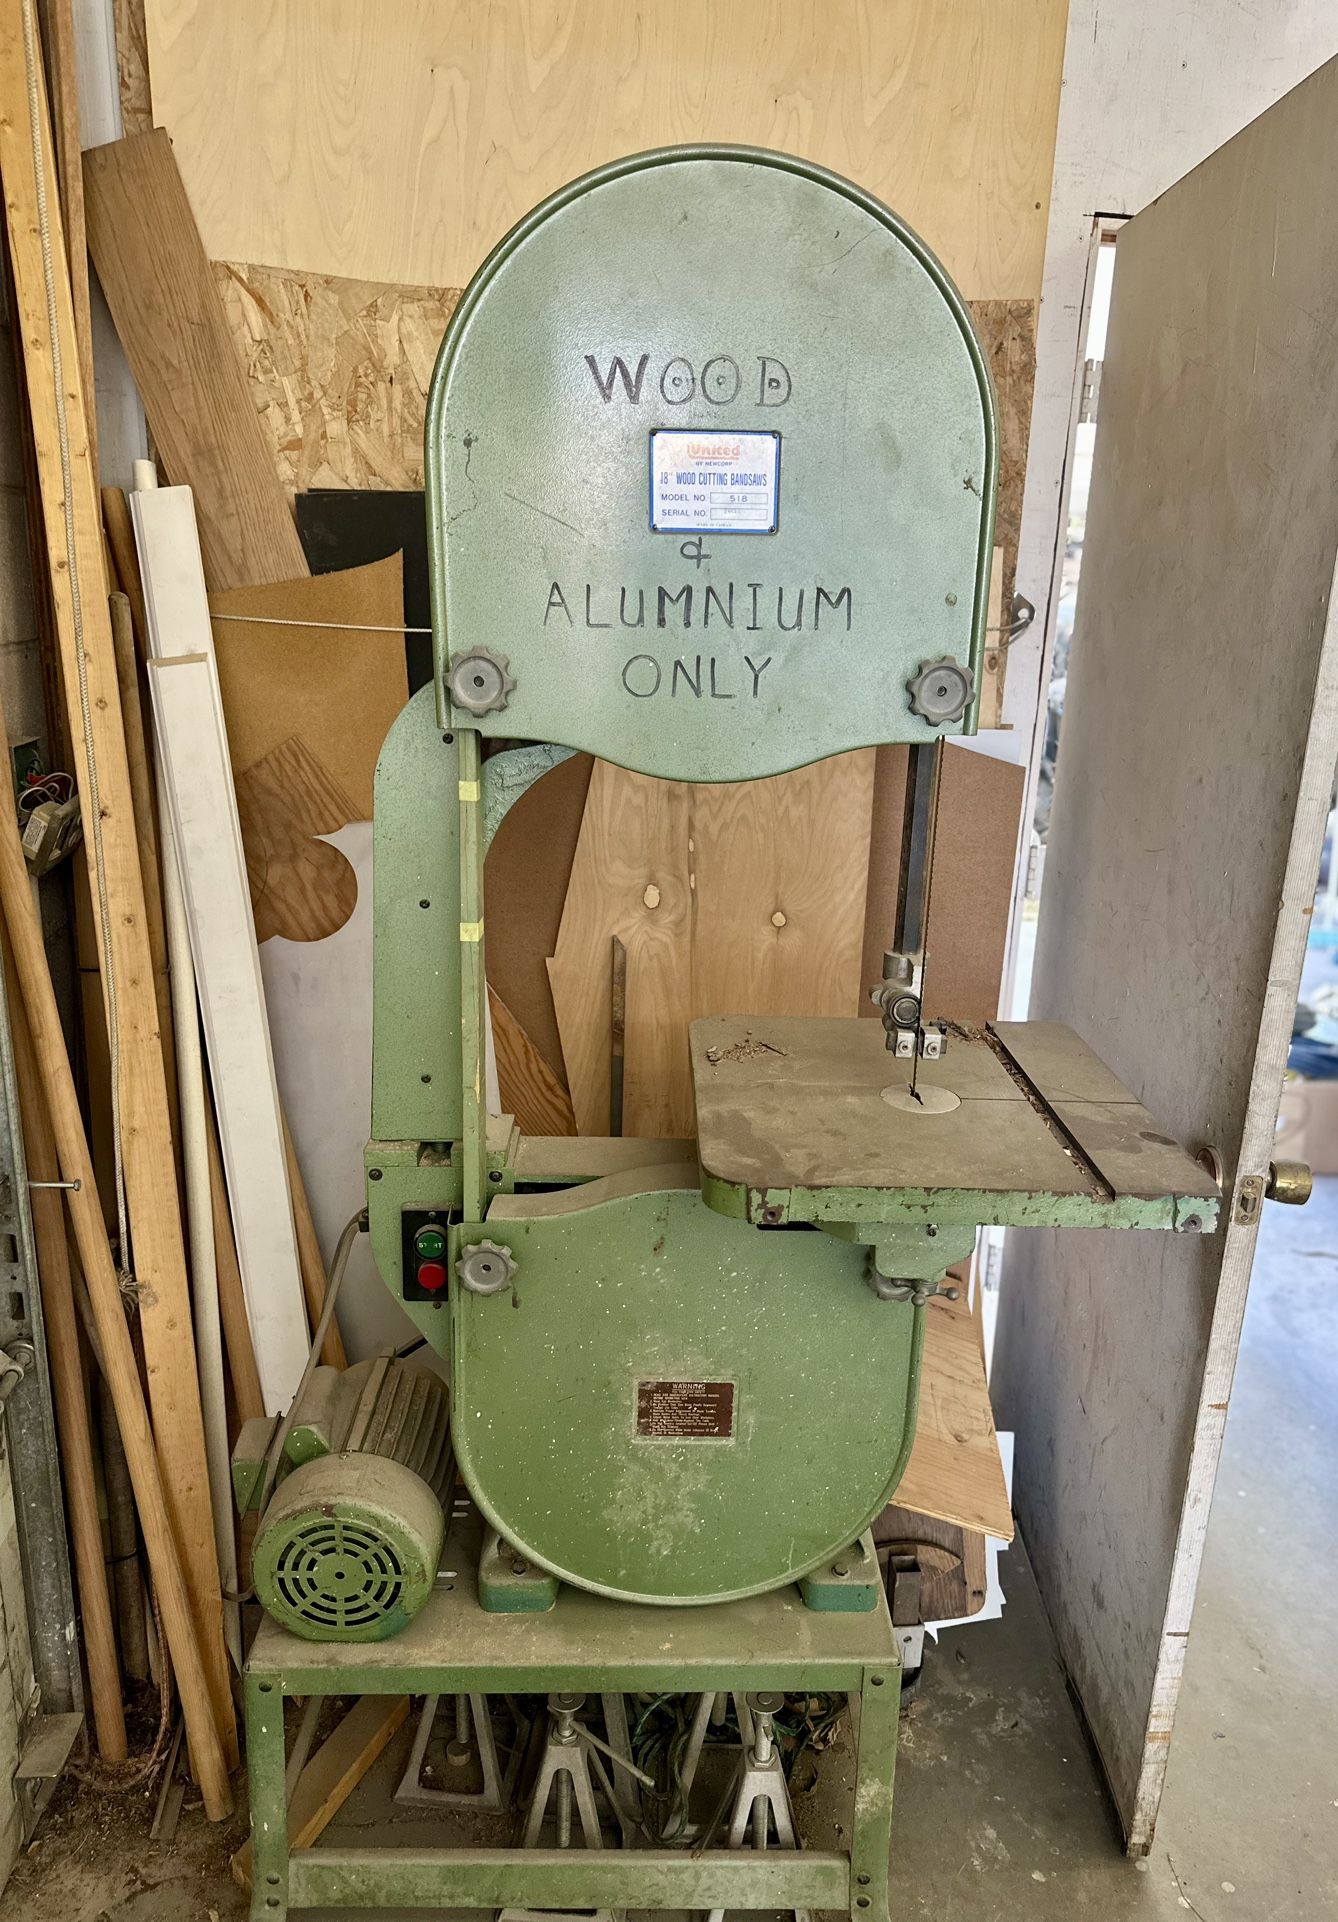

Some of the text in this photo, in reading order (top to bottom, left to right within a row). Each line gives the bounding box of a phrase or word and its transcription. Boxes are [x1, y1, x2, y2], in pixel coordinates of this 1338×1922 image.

[584, 353, 793, 408] WOOD
[688, 444, 740, 458] United
[676, 472, 696, 486] WOOD
[698, 472, 728, 486] CUTTING
[730, 473, 767, 486] BANDSAWS
[661, 493, 689, 502] MODEL
[729, 495, 748, 503] 518
[661, 508, 690, 517] SERIAL
[543, 581, 852, 631] ALUMNIUM
[621, 654, 772, 699] ONLY
